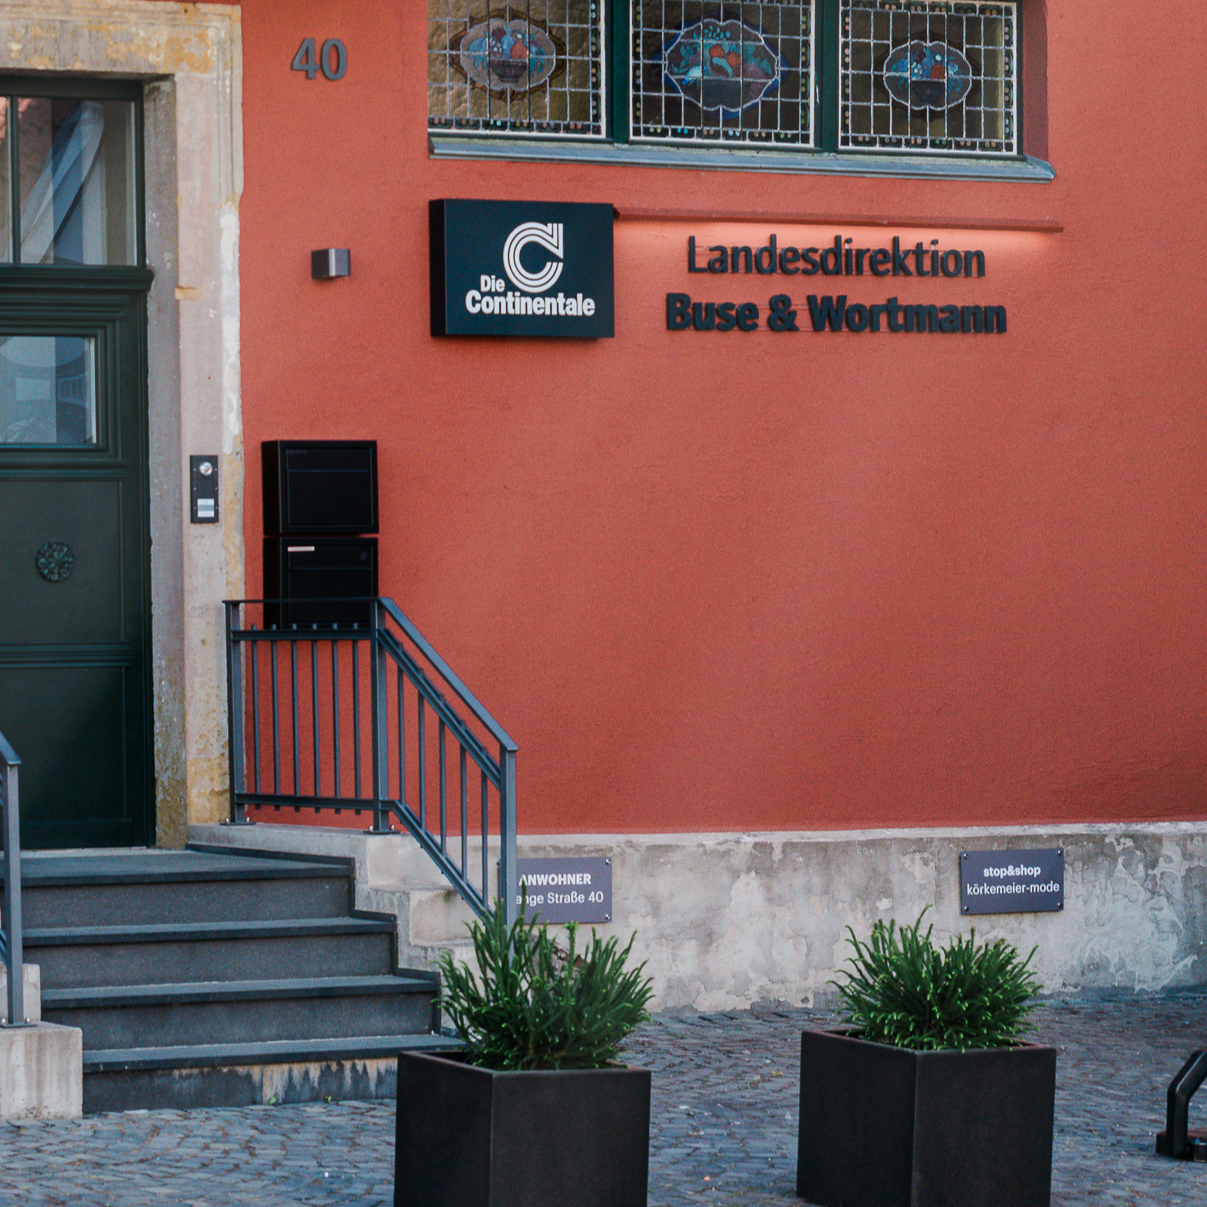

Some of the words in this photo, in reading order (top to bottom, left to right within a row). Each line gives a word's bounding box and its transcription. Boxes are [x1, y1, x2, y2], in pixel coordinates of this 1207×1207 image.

[291, 37, 347, 81] 40
[688, 233, 985, 277] Landesdirektion
[480, 275, 505, 292] Die
[465, 290, 595, 316] Continentale
[666, 292, 759, 331] Buse
[767, 294, 800, 332] &
[807, 295, 1007, 333] Wortmann
[519, 873, 592, 886] ANWOHNER
[983, 863, 1041, 879] stop&shop
[967, 880, 1060, 895] körkemeier-mode
[516, 895, 544, 907] age
[547, 891, 585, 904] Straße
[588, 891, 604, 903] 40
